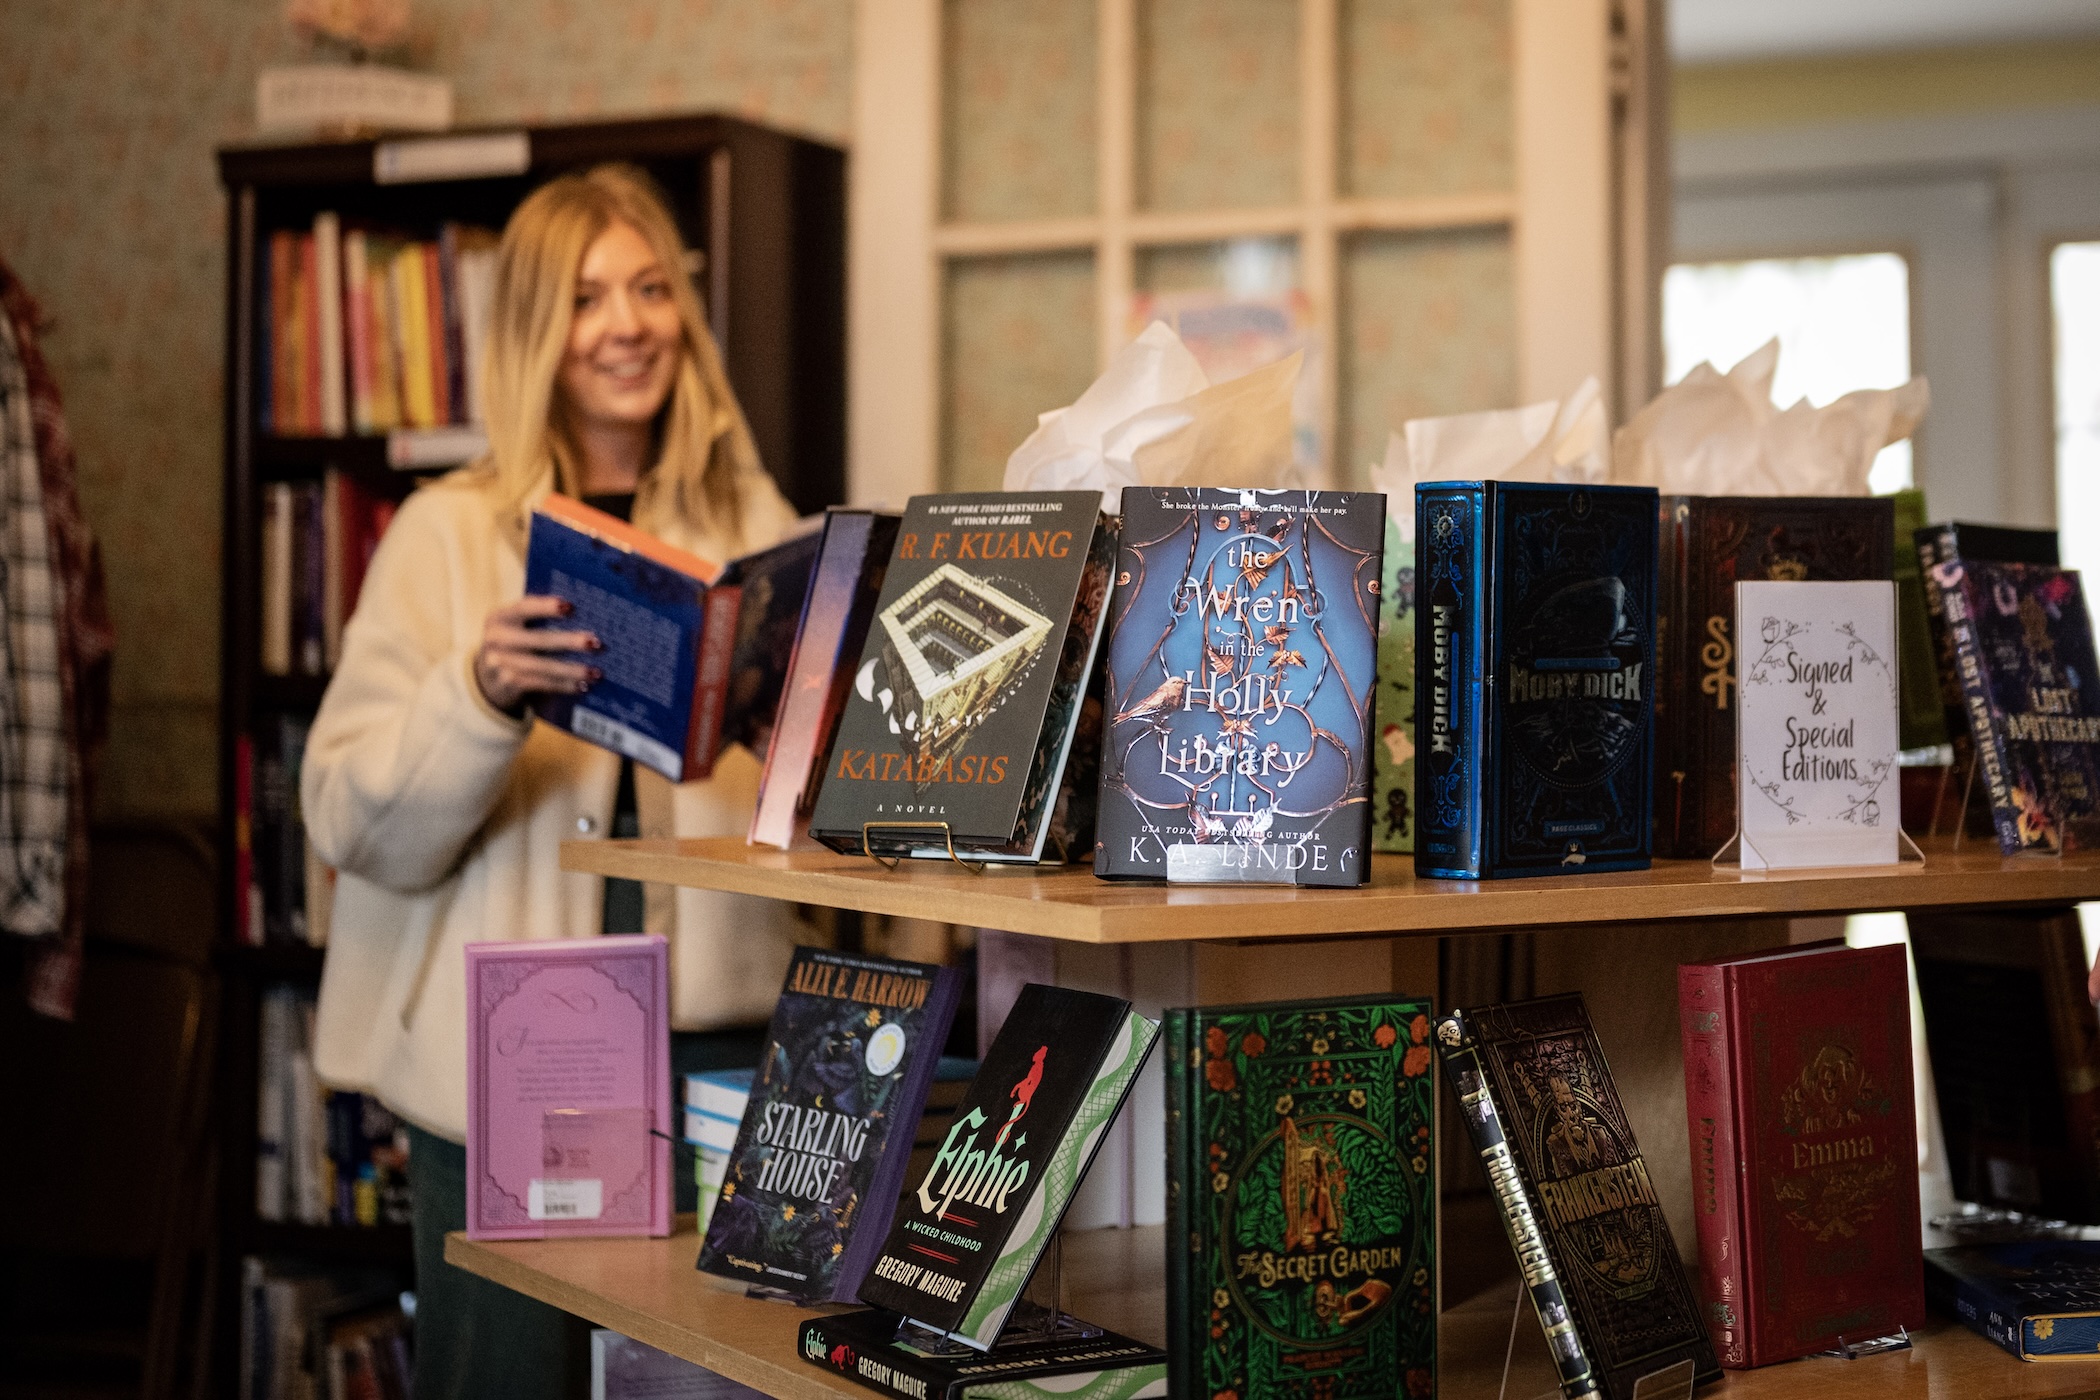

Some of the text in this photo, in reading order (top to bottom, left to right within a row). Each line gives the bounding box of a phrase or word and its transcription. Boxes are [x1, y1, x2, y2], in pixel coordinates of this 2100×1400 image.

[939, 505, 958, 514] NEW
[958, 505, 978, 514] YORK
[980, 504, 1006, 514] TIMES
[1006, 503, 1063, 514] BESTSELLING
[952, 515, 1032, 526] AUTHOR OF BABEL
[1161, 502, 1175, 510] She
[1176, 502, 1196, 511] broke
[1198, 503, 1210, 511] the
[1211, 502, 1240, 512] Monster
[1300, 505, 1318, 514] make
[1320, 506, 1332, 514] her
[1333, 507, 1348, 516] pay.
[901, 529, 1073, 560] R. F. KUANG
[1227, 541, 1269, 569] the
[1176, 576, 1300, 624] Wren
[1219, 640, 1265, 657] in the
[1431, 604, 1454, 755] MOBY DICK
[1509, 662, 1580, 704] MOBY
[1583, 661, 1643, 701] DICK
[1787, 651, 1853, 698] Signed
[1183, 670, 1293, 726] Holly
[1812, 688, 1828, 716] &
[1786, 716, 1854, 759] Special
[1969, 696, 2009, 808] APOTHECARY
[836, 749, 1009, 784] KATABASIS
[1159, 733, 1306, 790] Library
[1783, 749, 1858, 782] Editions
[876, 804, 947, 814] A NOVEL
[1141, 825, 1161, 834] USA
[1166, 826, 1199, 836] TODAY
[1278, 831, 1321, 841] AUTHOR
[1221, 840, 1330, 871] LINDE
[788, 961, 835, 997] ALIX
[851, 969, 933, 1010] HARROW
[757, 1100, 871, 1162] STARLING
[1792, 1135, 1875, 1169] Emma
[756, 1147, 845, 1204] HOUSE
[916, 1102, 1030, 1222] Elphie
[1481, 1140, 1557, 1288] FRANKENSTEIN
[1538, 1156, 1658, 1231] FRANKENSTEIN
[904, 1220, 982, 1252] A WICKED CHILDHOOD
[875, 1254, 967, 1304] GREGORY MAGUIRE
[1236, 1245, 1402, 1289] The SECRET GARDEN
[805, 1327, 828, 1361] Elphie
[957, 1357, 1049, 1375] GREGORY
[1054, 1346, 1148, 1363] MAGUIRE
[858, 1355, 928, 1400] GREGORY MAGUIRE
